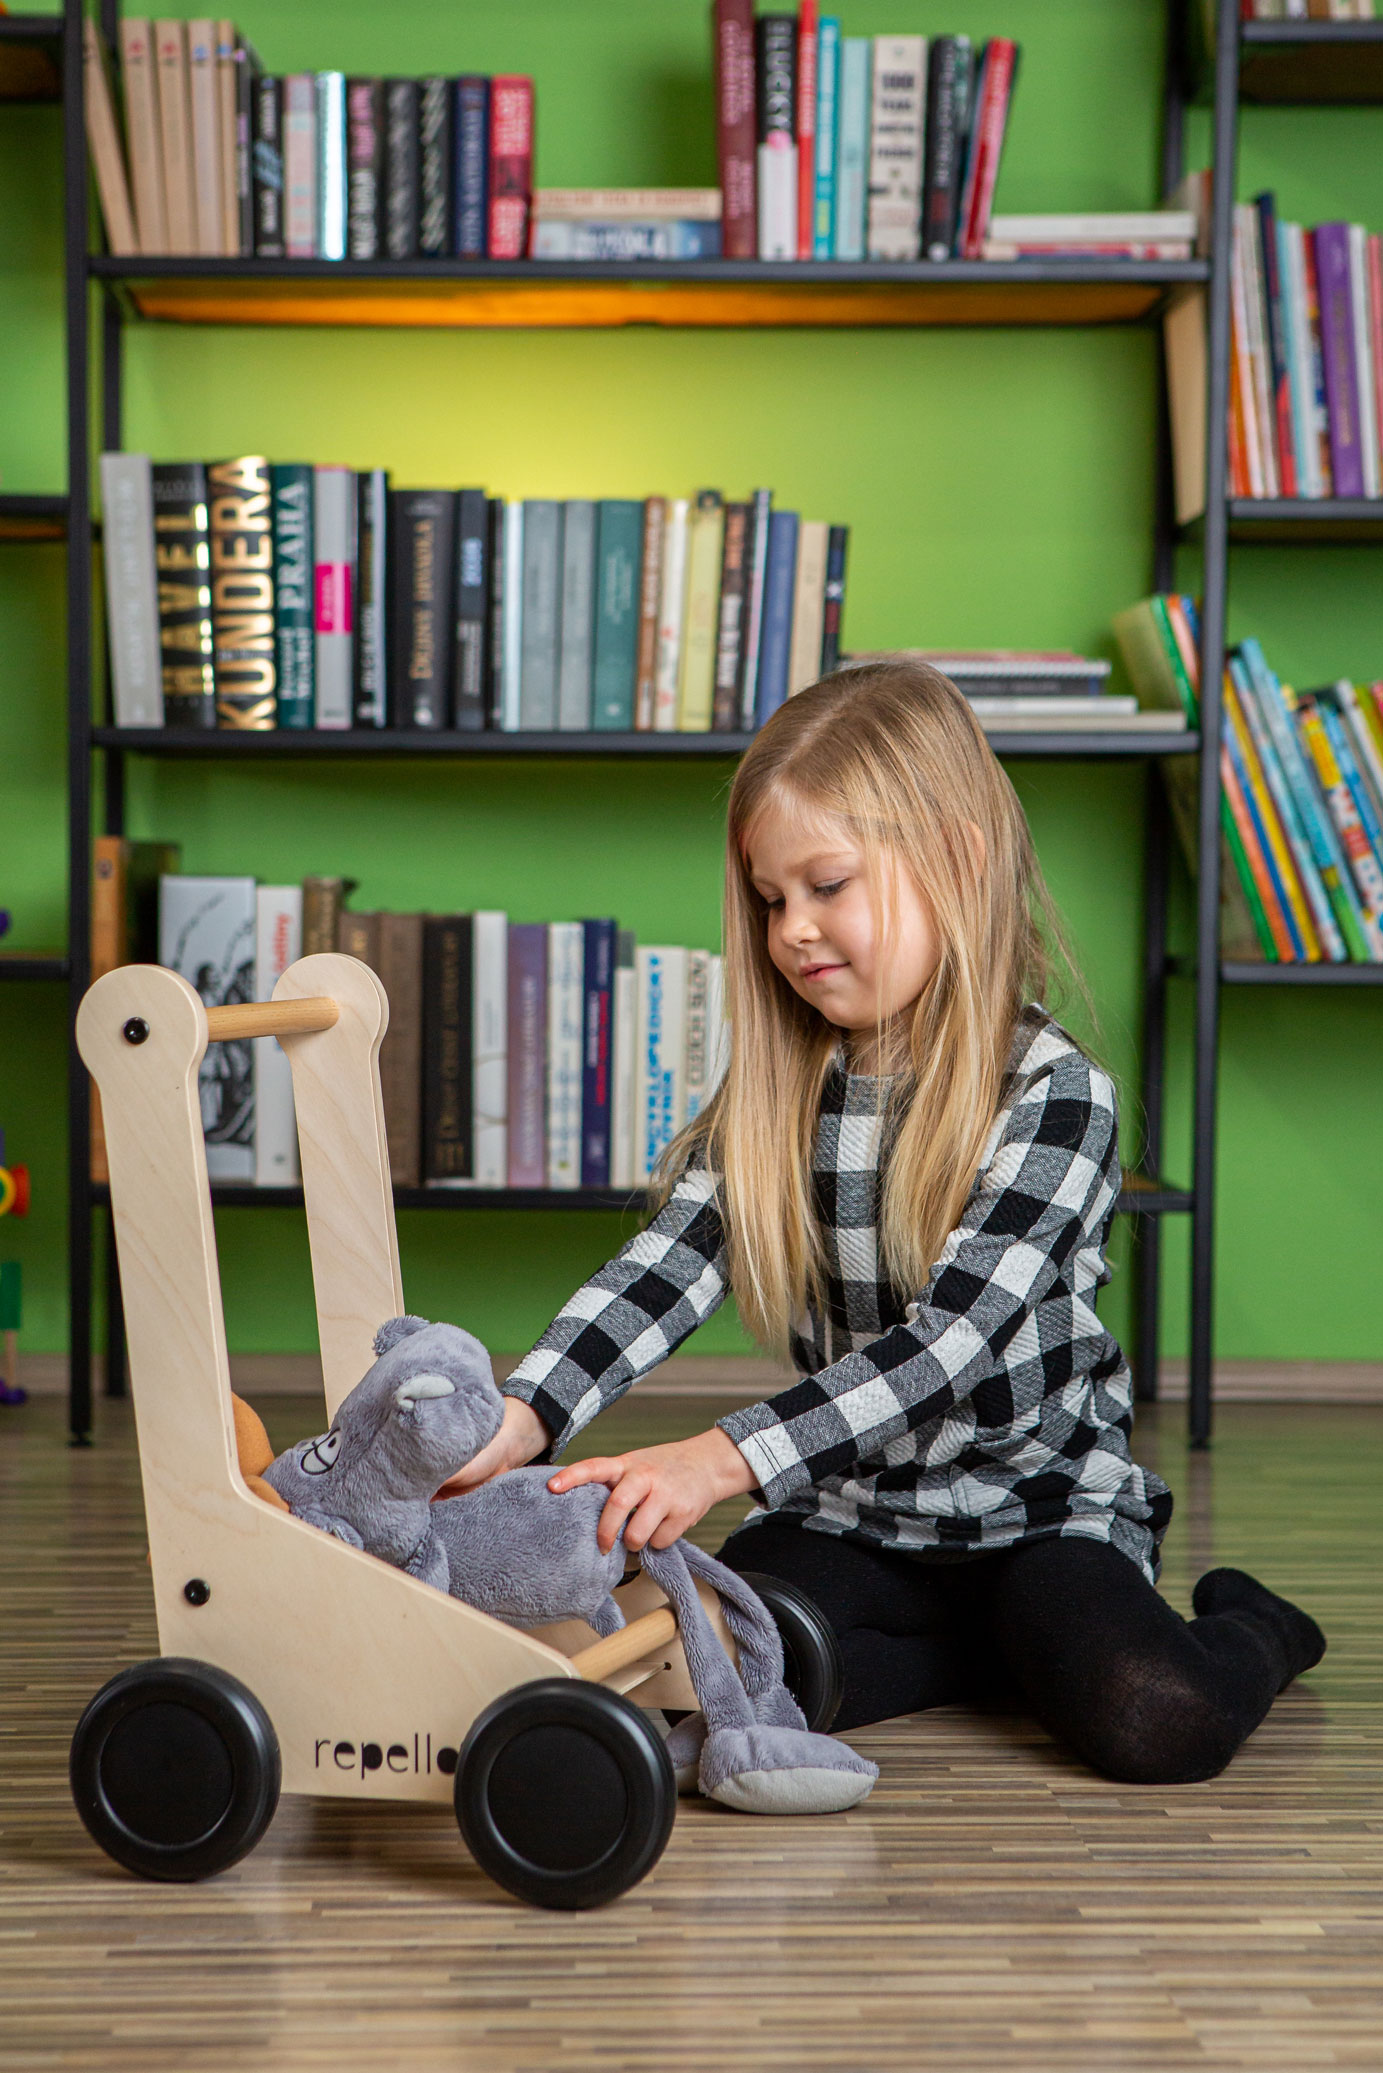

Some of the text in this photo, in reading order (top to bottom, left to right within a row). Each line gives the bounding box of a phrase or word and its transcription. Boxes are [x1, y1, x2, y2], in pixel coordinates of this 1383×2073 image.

[155, 502, 215, 696] HAVEL
[210, 455, 277, 731] KUNDERA
[277, 481, 306, 611] PRAHA
[315, 1732, 459, 1781] repello
